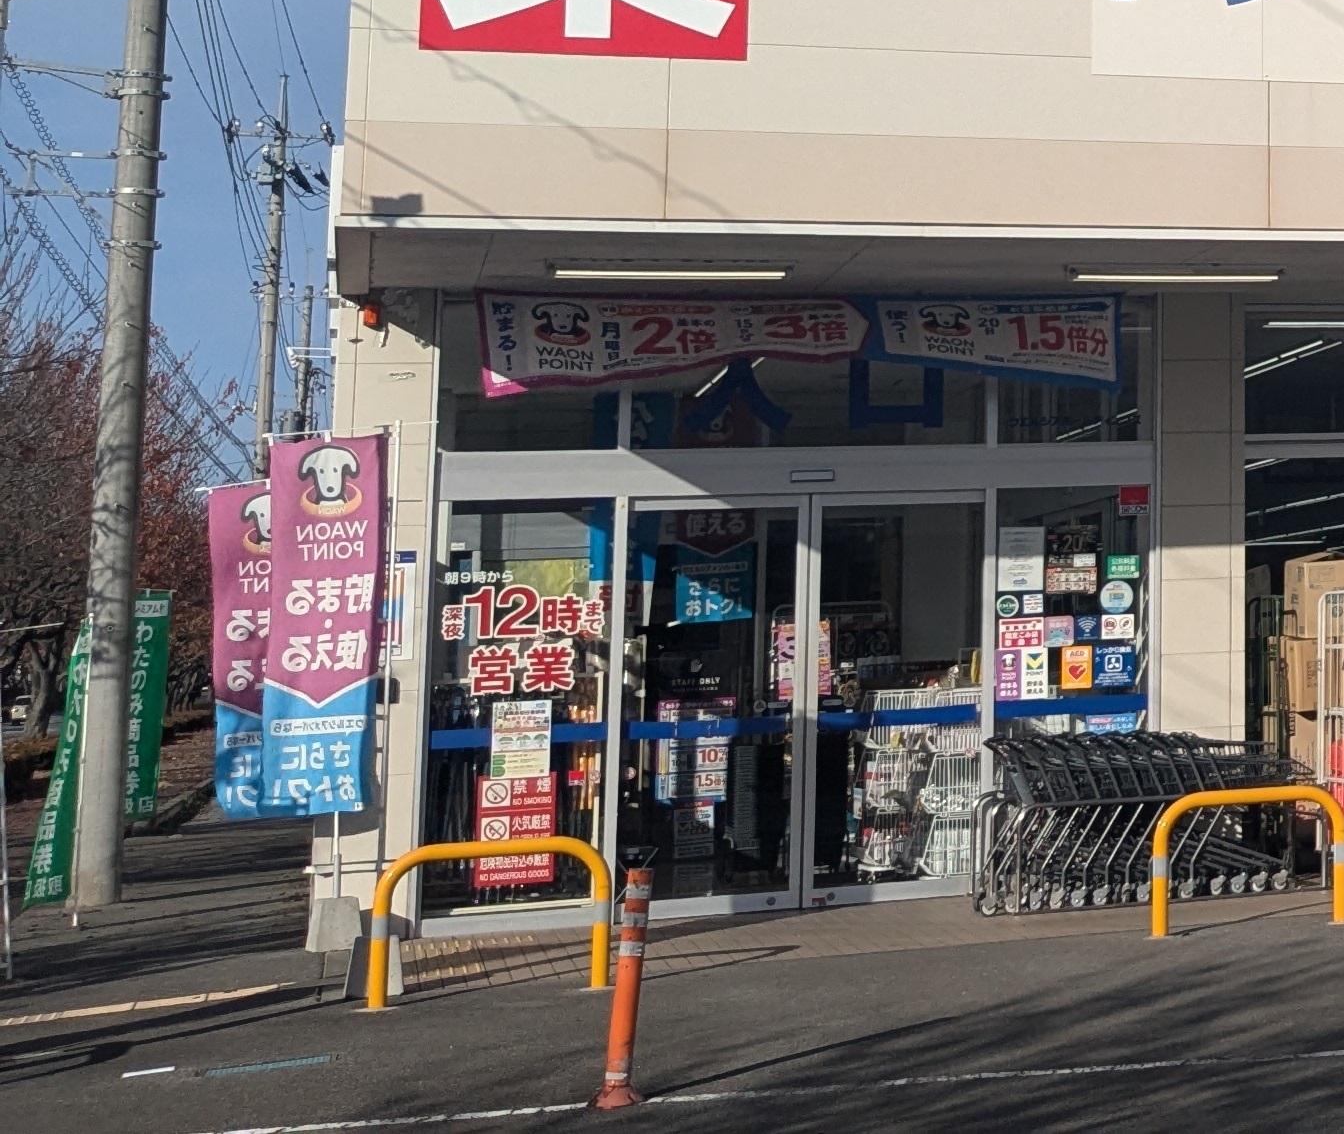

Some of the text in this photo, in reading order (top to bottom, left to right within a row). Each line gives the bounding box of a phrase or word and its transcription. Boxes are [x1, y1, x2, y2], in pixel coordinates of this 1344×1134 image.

[923, 334, 975, 348] WAON
[535, 346, 594, 361] WAON
[927, 343, 976, 357] POINT
[538, 358, 594, 372] POINT
[444, 570, 514, 585] 朝9時から
[468, 644, 575, 695] 営業
